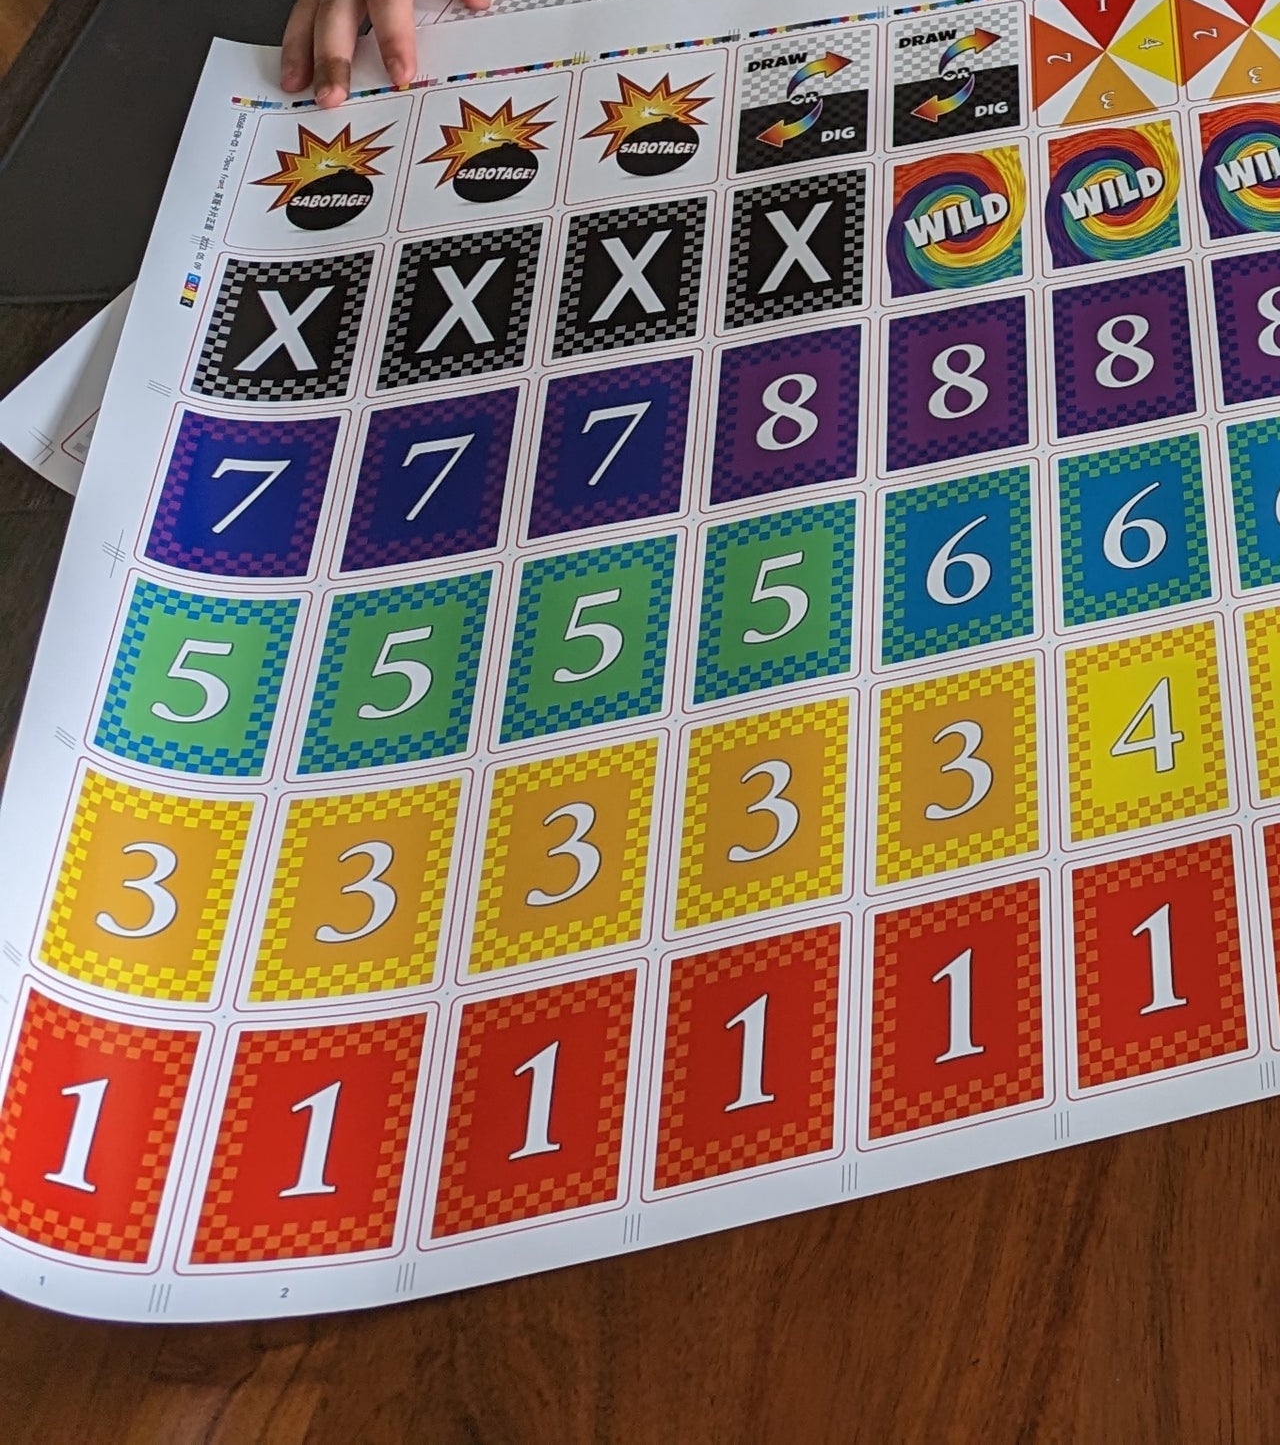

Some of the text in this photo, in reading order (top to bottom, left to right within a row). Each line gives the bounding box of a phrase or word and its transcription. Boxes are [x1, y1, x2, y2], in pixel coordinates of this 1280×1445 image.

[748, 53, 807, 73] DRAW
[898, 29, 957, 48] DRAW
[942, 67, 970, 81] OR
[788, 90, 819, 105] OR
[820, 126, 856, 143] DIG
[974, 101, 1008, 118] DIG
[456, 165, 535, 182] SABOTAGE!
[618, 140, 697, 156] SABOTAGE!
[288, 193, 369, 210] SABOTAGE!
[904, 193, 1010, 249] WILD
[1061, 166, 1164, 221] WILD
[588, 229, 673, 324] X
[758, 200, 834, 295] X
[233, 285, 335, 373] X
[416, 257, 506, 354] X
[928, 344, 990, 420] 8
[1095, 314, 1156, 389] 8
[582, 401, 653, 487] 7
[756, 373, 820, 452] 8
[211, 458, 292, 535] 7
[402, 433, 476, 522] 7
[926, 515, 992, 606] 6
[1103, 482, 1168, 570] 6
[553, 588, 624, 683] 5
[743, 551, 809, 644] 5
[151, 639, 233, 724] 5
[358, 625, 433, 720] 5
[1111, 678, 1184, 773] 4
[728, 760, 799, 862] 3
[925, 721, 993, 820] 3
[95, 842, 178, 938] 3
[316, 841, 397, 943] 3
[526, 803, 601, 907] 3
[1132, 903, 1188, 1016] 1
[932, 948, 985, 1064] 1
[725, 994, 775, 1113] 1
[44, 1078, 110, 1194] 1
[279, 1081, 342, 1198] 1
[509, 1041, 561, 1161] 1
